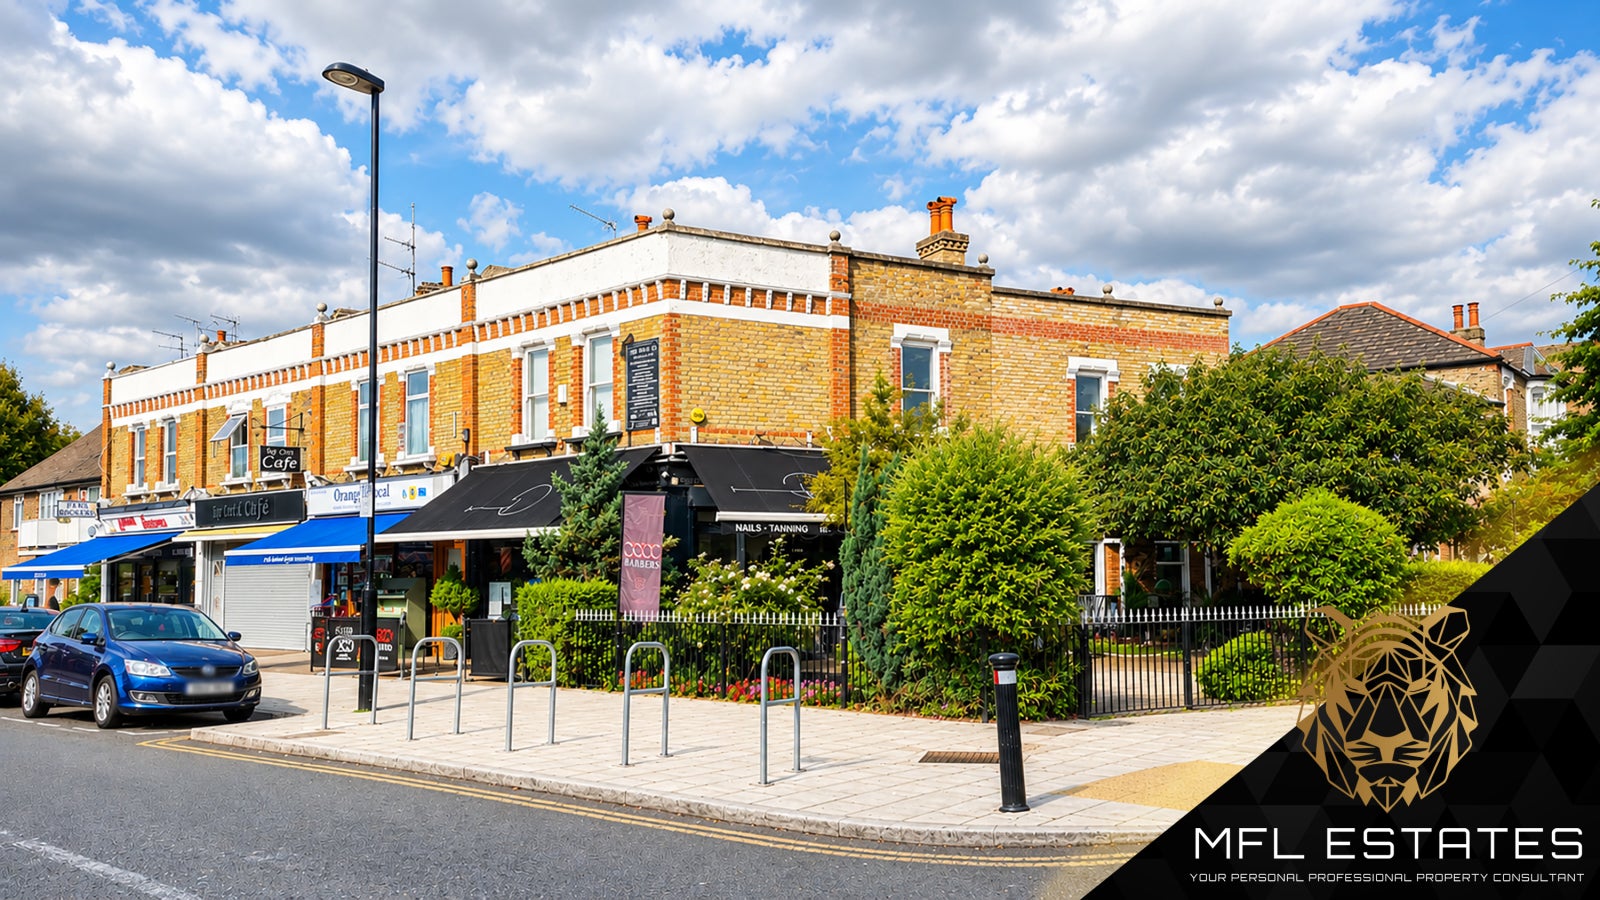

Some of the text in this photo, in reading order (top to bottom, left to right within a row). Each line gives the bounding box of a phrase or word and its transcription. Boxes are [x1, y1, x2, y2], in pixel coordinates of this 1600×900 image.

[262, 455, 298, 471] Cafe
[735, 523, 762, 532] NAILS
[769, 524, 809, 533] TANNING
